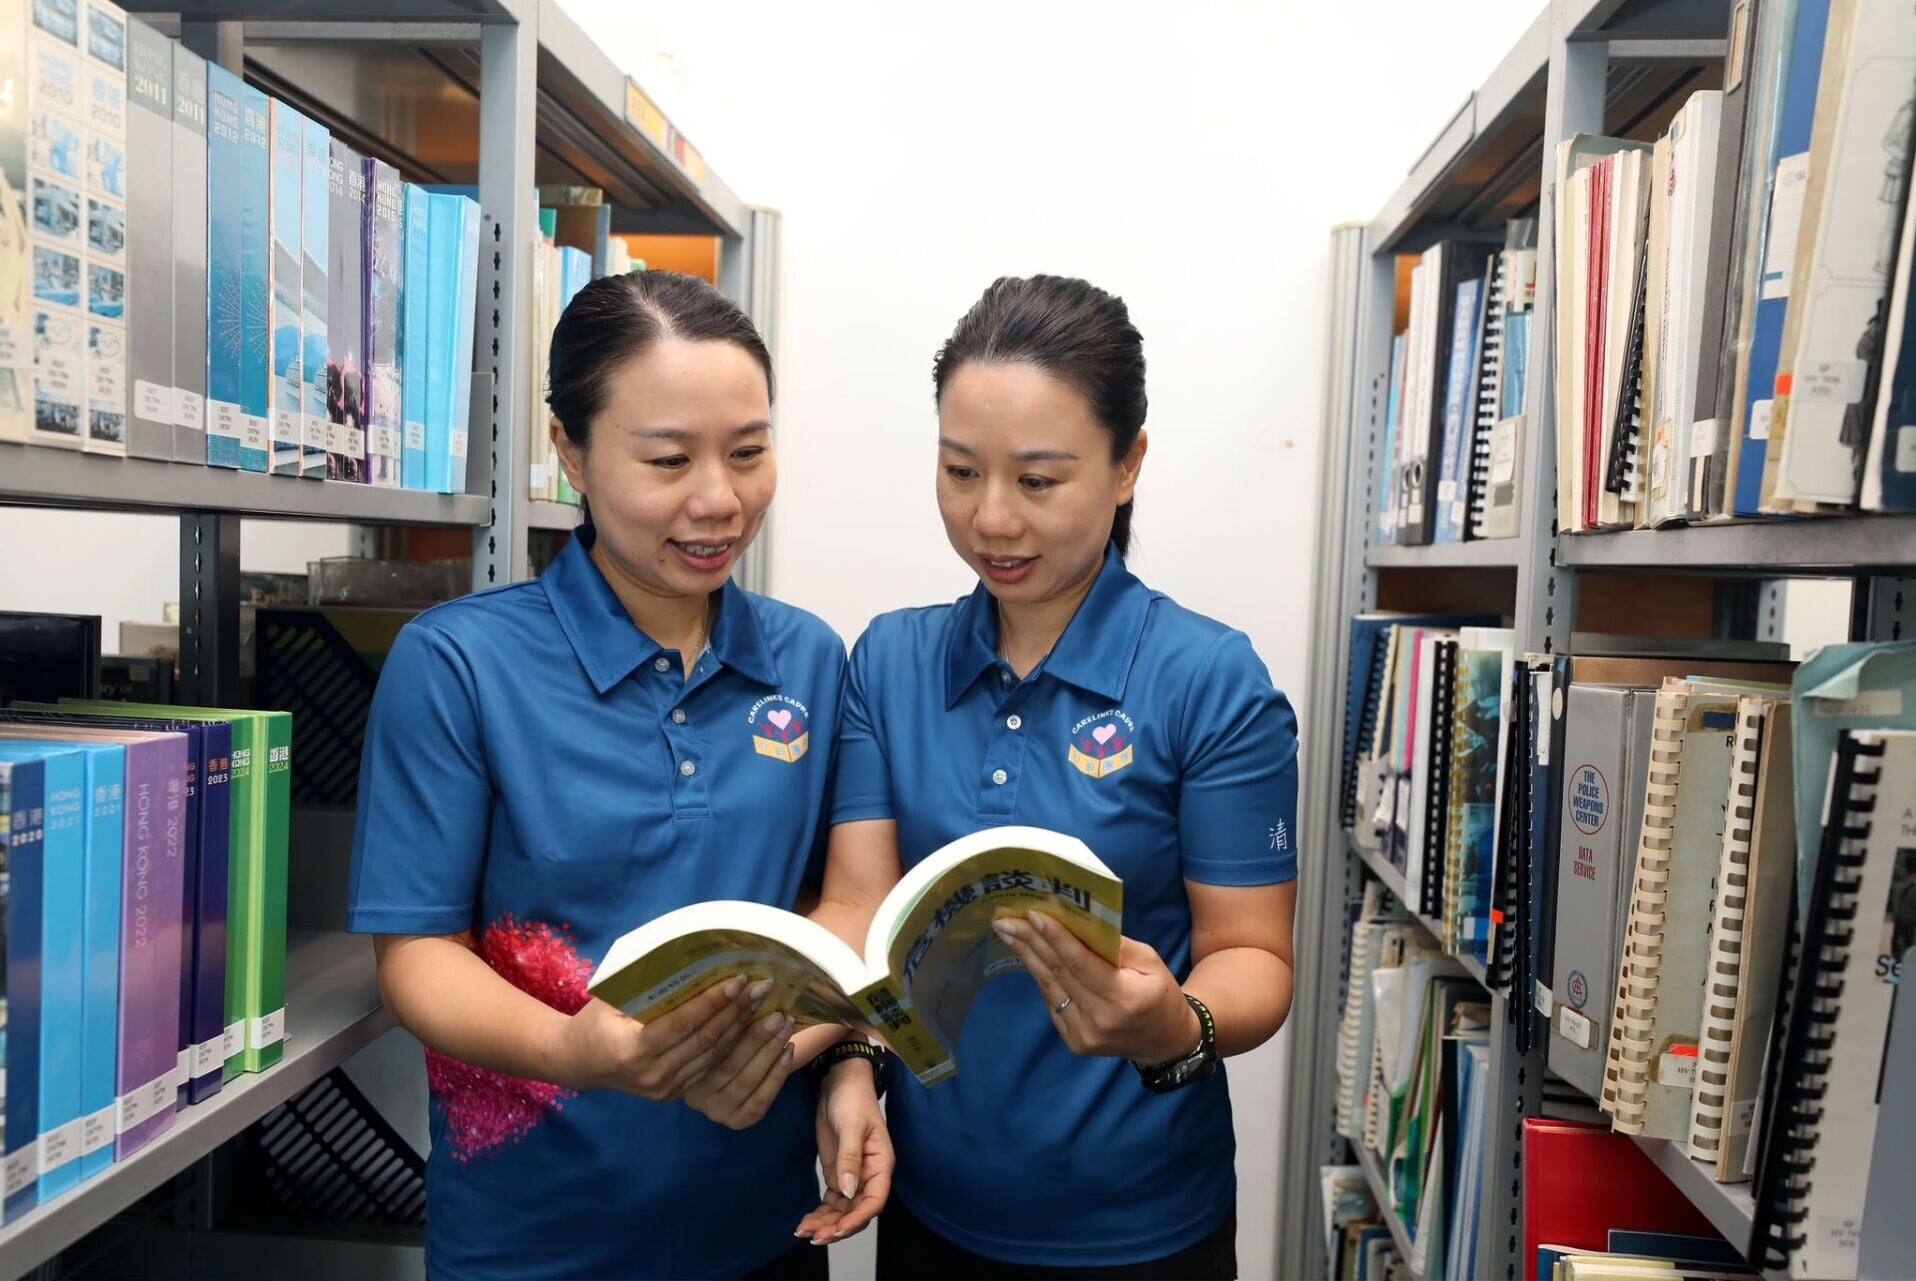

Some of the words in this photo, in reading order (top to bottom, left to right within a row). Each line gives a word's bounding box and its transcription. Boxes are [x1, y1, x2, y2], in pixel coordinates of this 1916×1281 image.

[134, 74, 167, 106] 2011
[177, 95, 204, 125] 2011
[214, 121, 239, 145] 2012
[244, 127, 267, 150] 2012
[329, 157, 345, 172] ONG
[329, 170, 345, 185] ONG
[329, 183, 344, 197] 014
[377, 180, 398, 198] HONG
[377, 193, 398, 211] KONG
[376, 205, 397, 223] 2015
[748, 694, 783, 724] CARELINKS
[1072, 709, 1114, 734] CARELINKS
[269, 746, 289, 762] 香港
[208, 757, 229, 772] 香港
[269, 761, 289, 774] 2024
[207, 774, 229, 786] 2023
[1584, 770, 1596, 784] THE
[95, 783, 121, 803] 香港
[1578, 783, 1600, 799] POLICE
[137, 783, 150, 840] HONG
[1573, 795, 1604, 815] WEAPONS
[1575, 810, 1600, 828] CENTER
[12, 830, 43, 847] 2020
[166, 817, 179, 858] 2022
[1269, 818, 1288, 851] 清
[1579, 845, 1594, 863] DATA
[135, 846, 149, 901] KONG
[1573, 860, 1596, 881] SERVICE
[134, 905, 148, 949] 2022
